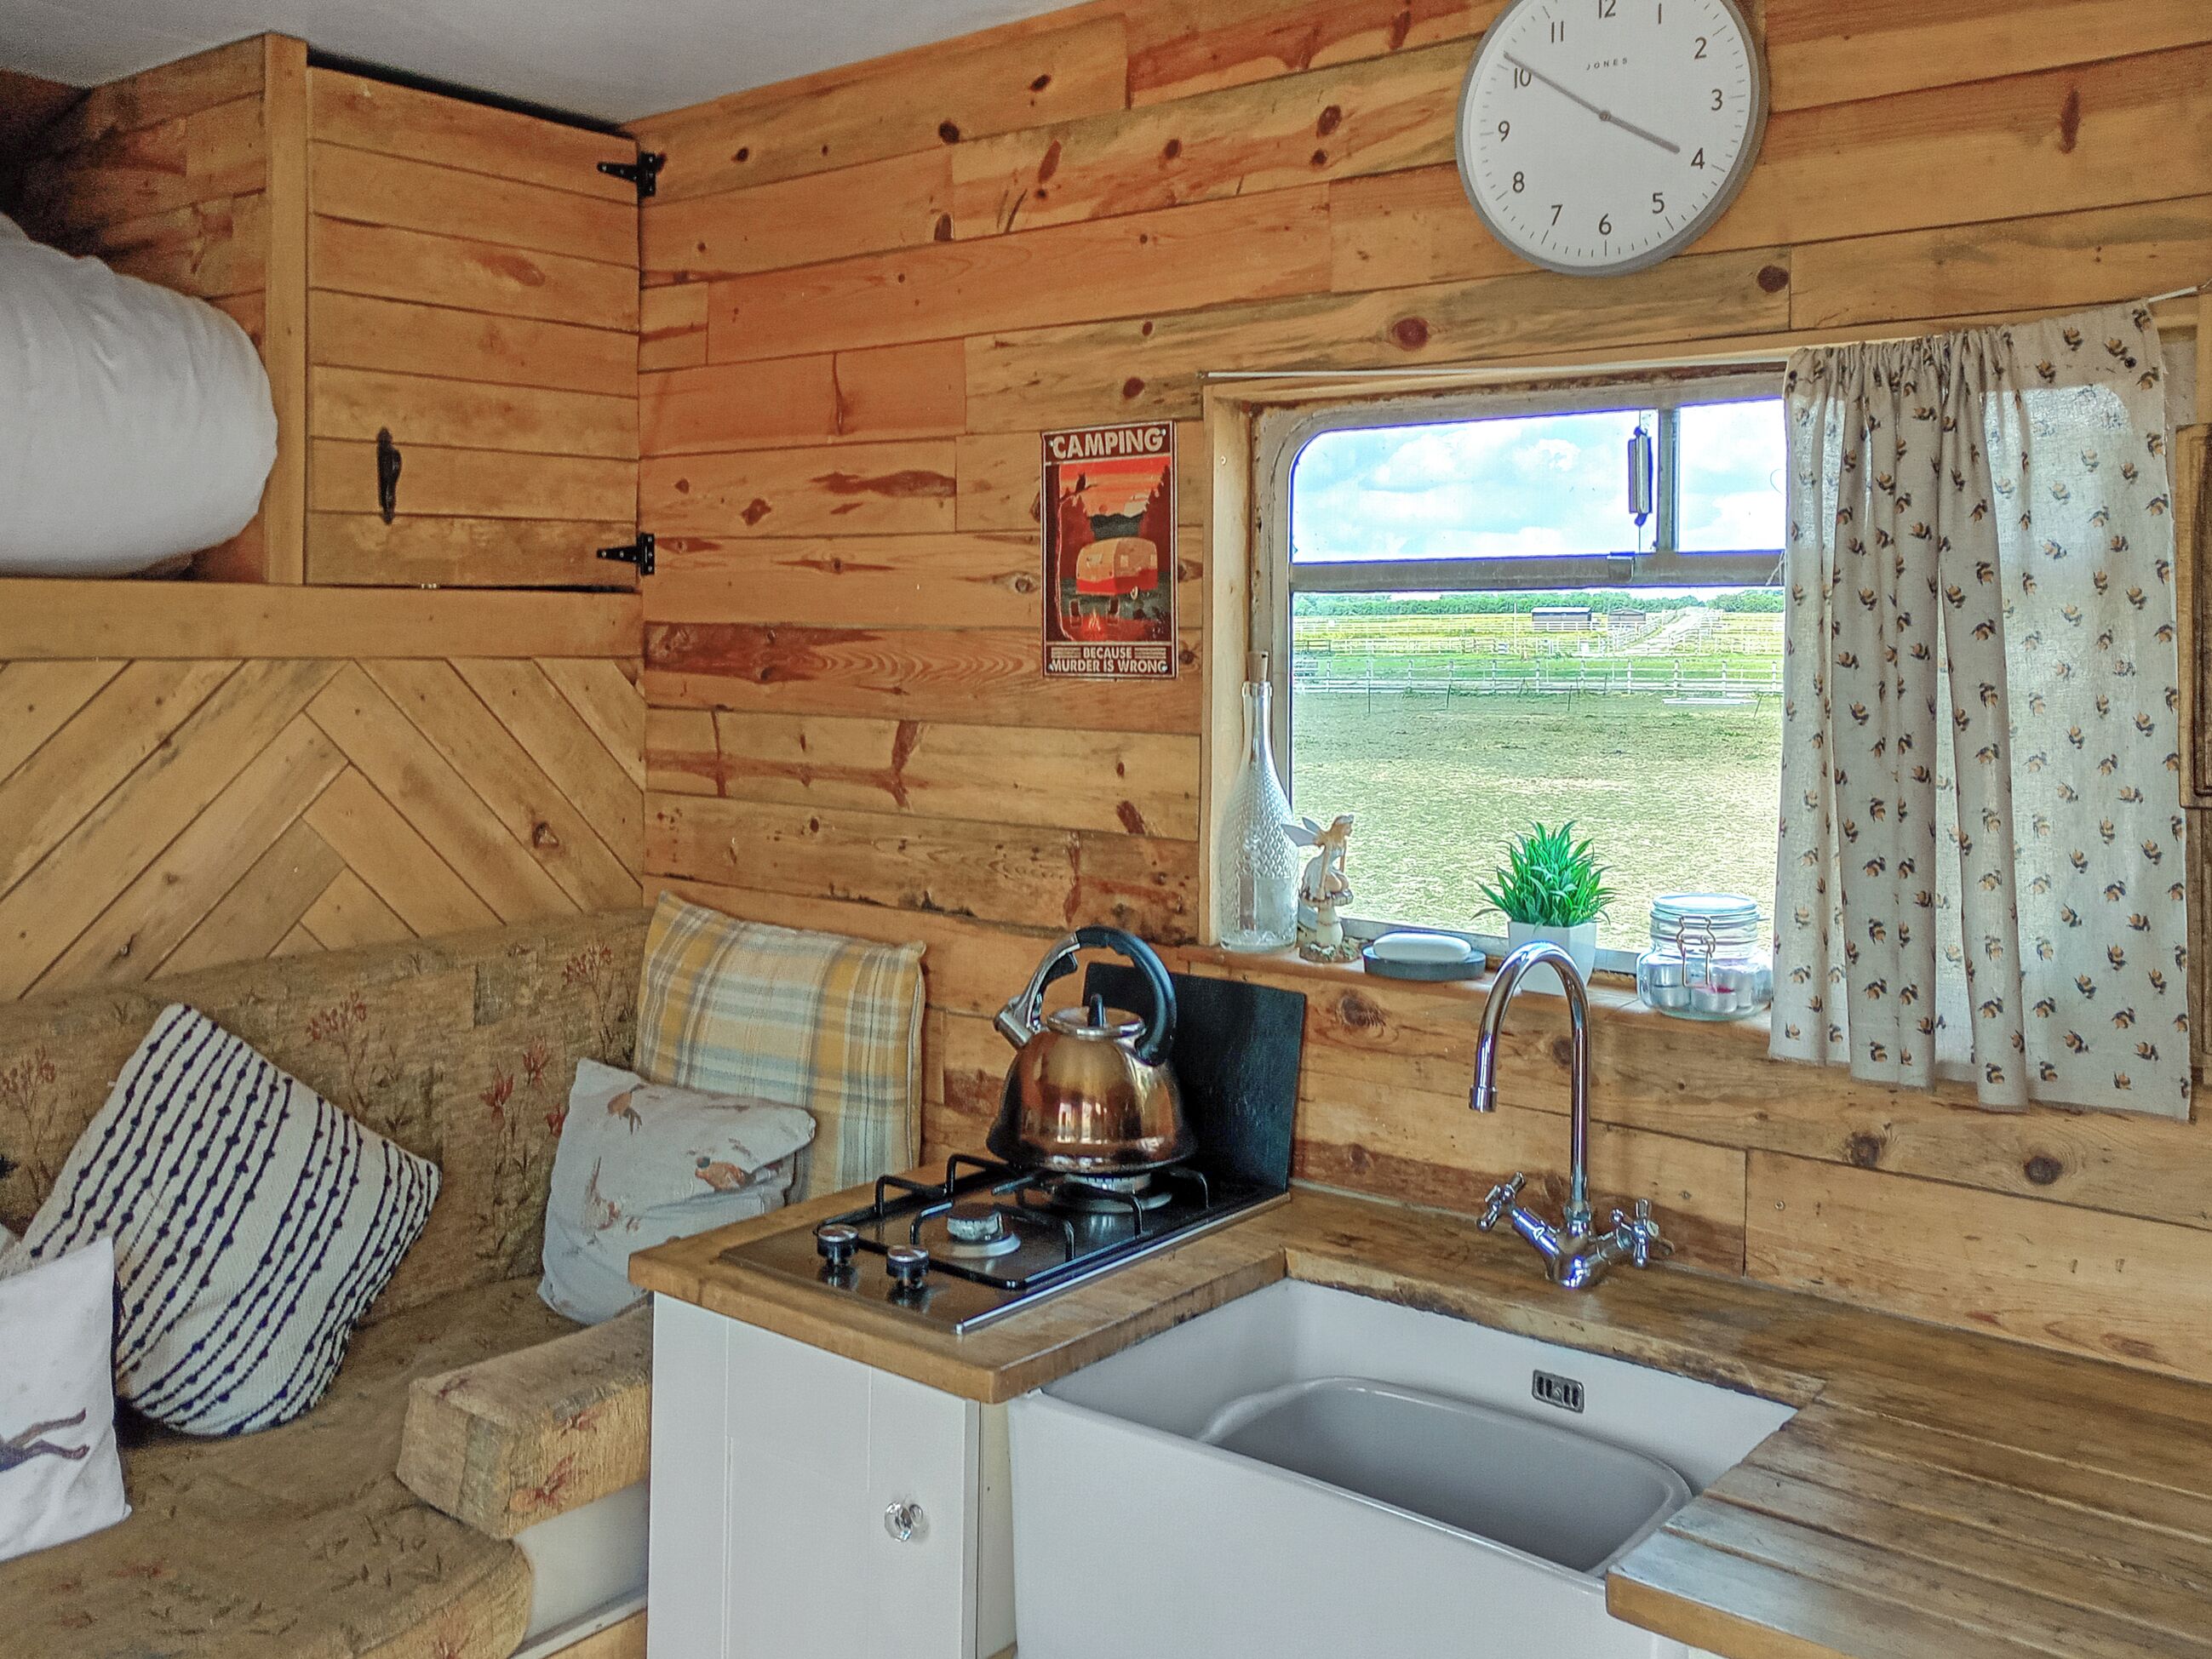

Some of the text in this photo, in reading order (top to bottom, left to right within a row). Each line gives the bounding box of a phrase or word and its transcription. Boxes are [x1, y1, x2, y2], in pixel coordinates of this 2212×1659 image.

[1598, 0, 1616, 19] 12
[1550, 20, 1565, 43] 11
[1693, 37, 1707, 60] 2
[1586, 57, 1628, 71] JONES
[1513, 67, 1533, 89] 10
[1711, 89, 1724, 112] 3
[1498, 120, 1510, 142] 9
[1690, 147, 1705, 170] 4
[1512, 170, 1525, 194] 8
[1551, 203, 1564, 226] 7
[1652, 192, 1665, 215] 5
[1598, 213, 1612, 236] 6
[1052, 427, 1163, 459] CAMPING
[1083, 647, 1132, 659] BECAUSE
[1051, 659, 1167, 672] MURDER IS WRONG
